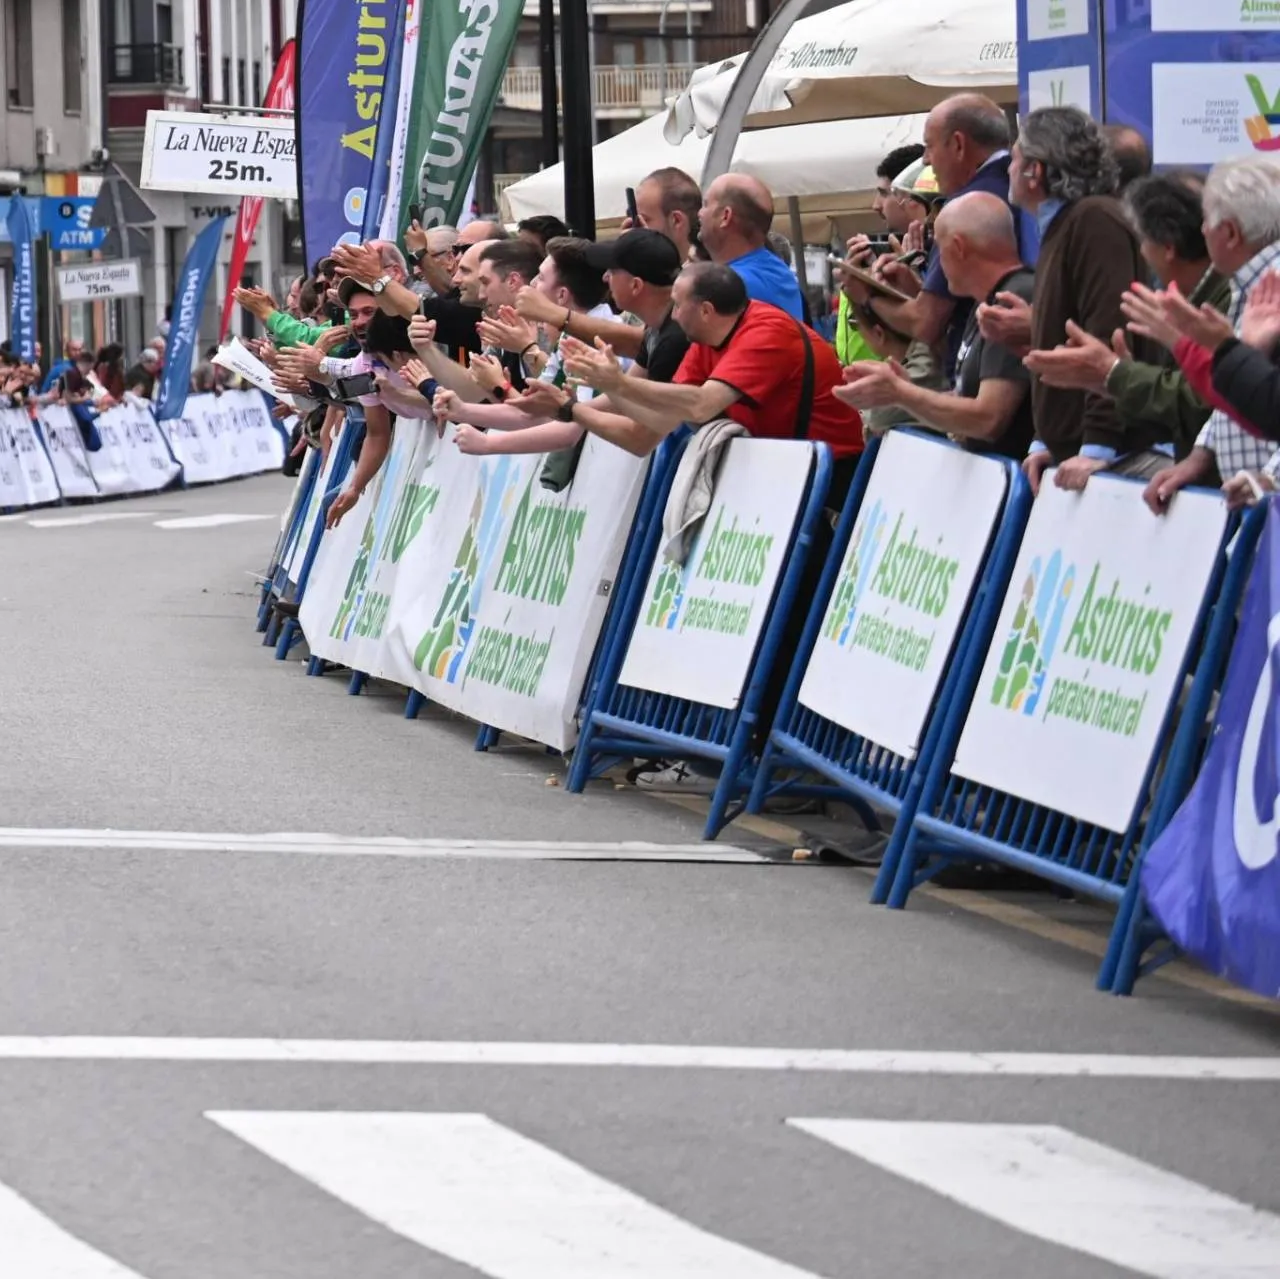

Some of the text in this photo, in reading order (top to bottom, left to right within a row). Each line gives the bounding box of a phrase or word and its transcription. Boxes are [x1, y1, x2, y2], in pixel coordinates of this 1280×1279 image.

[165, 127, 187, 151] La
[193, 128, 247, 153] Nueva
[208, 160, 272, 182] 25m.
[60, 231, 93, 244] ATM
[494, 462, 587, 607] Asturias
[696, 503, 774, 587] Asturias
[871, 512, 959, 618] Asturias
[849, 607, 935, 673] paraíso natural
[1063, 561, 1171, 676] Asturias
[1043, 669, 1146, 737] paraíso natural
